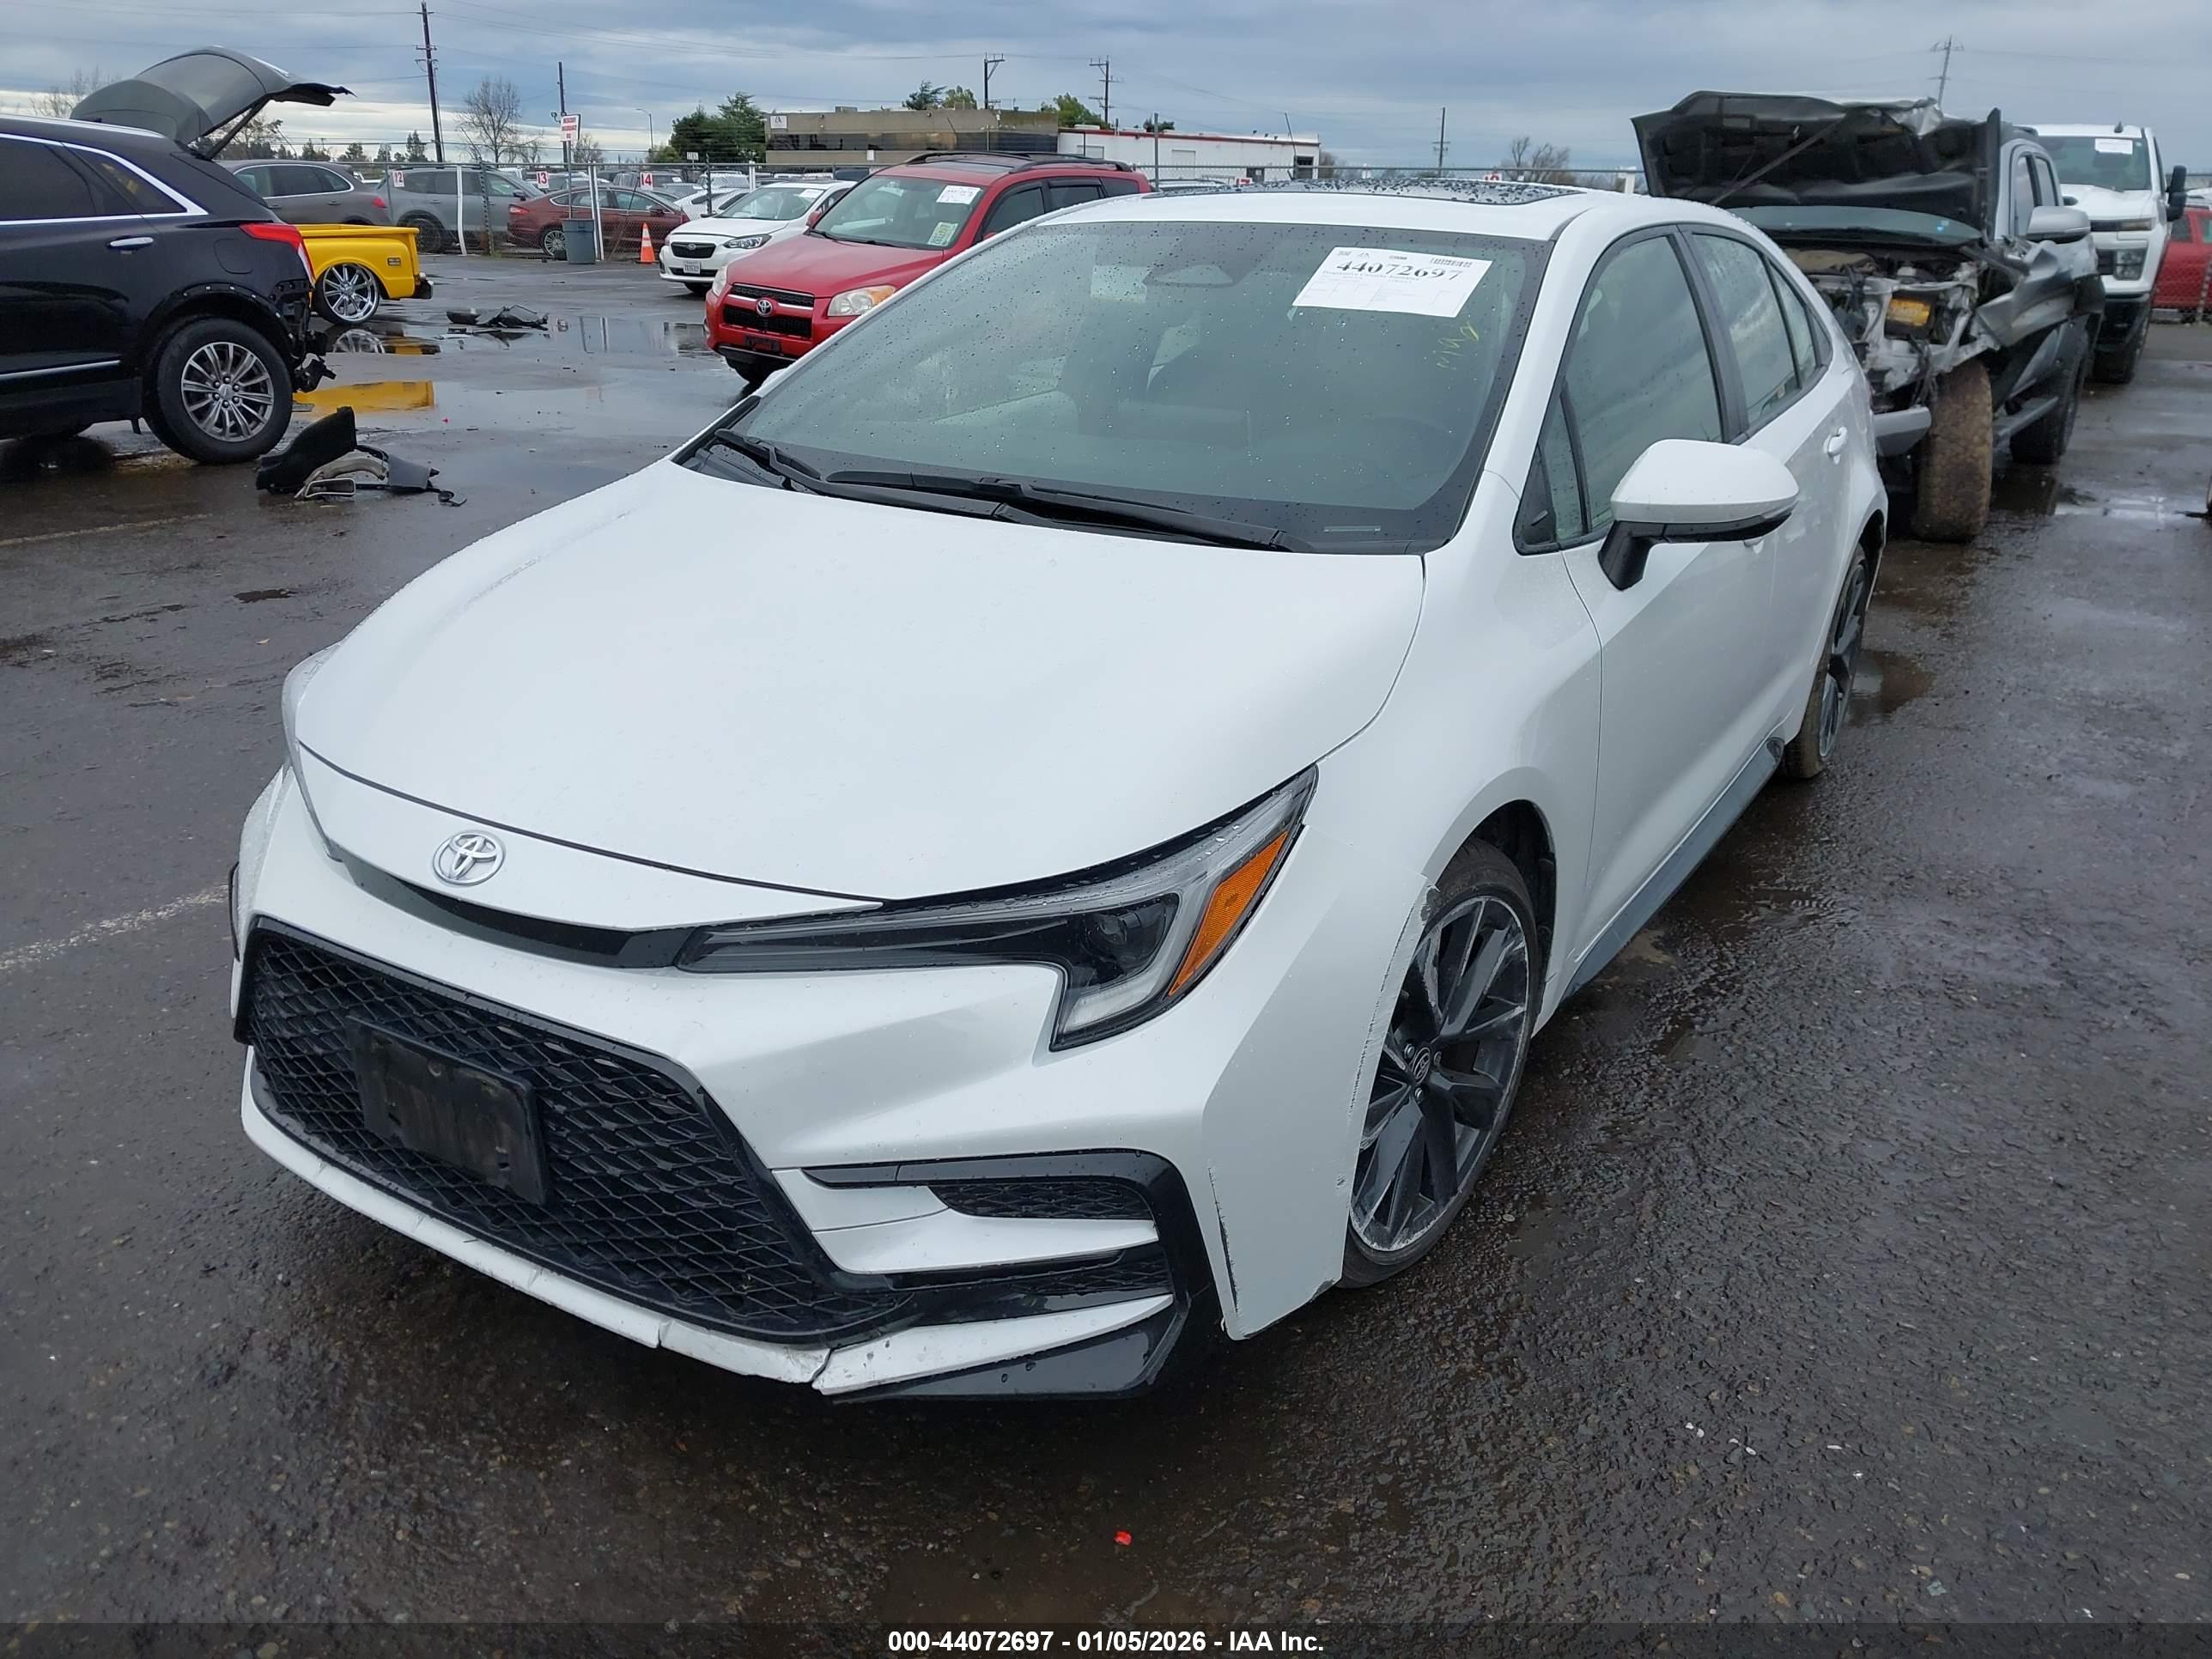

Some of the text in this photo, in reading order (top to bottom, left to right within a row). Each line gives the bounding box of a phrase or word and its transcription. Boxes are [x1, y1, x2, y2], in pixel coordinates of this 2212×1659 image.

[394, 172, 403, 183] 12
[537, 172, 548, 185] 13
[641, 173, 653, 186] 14
[1336, 260, 1464, 281] 44072697
